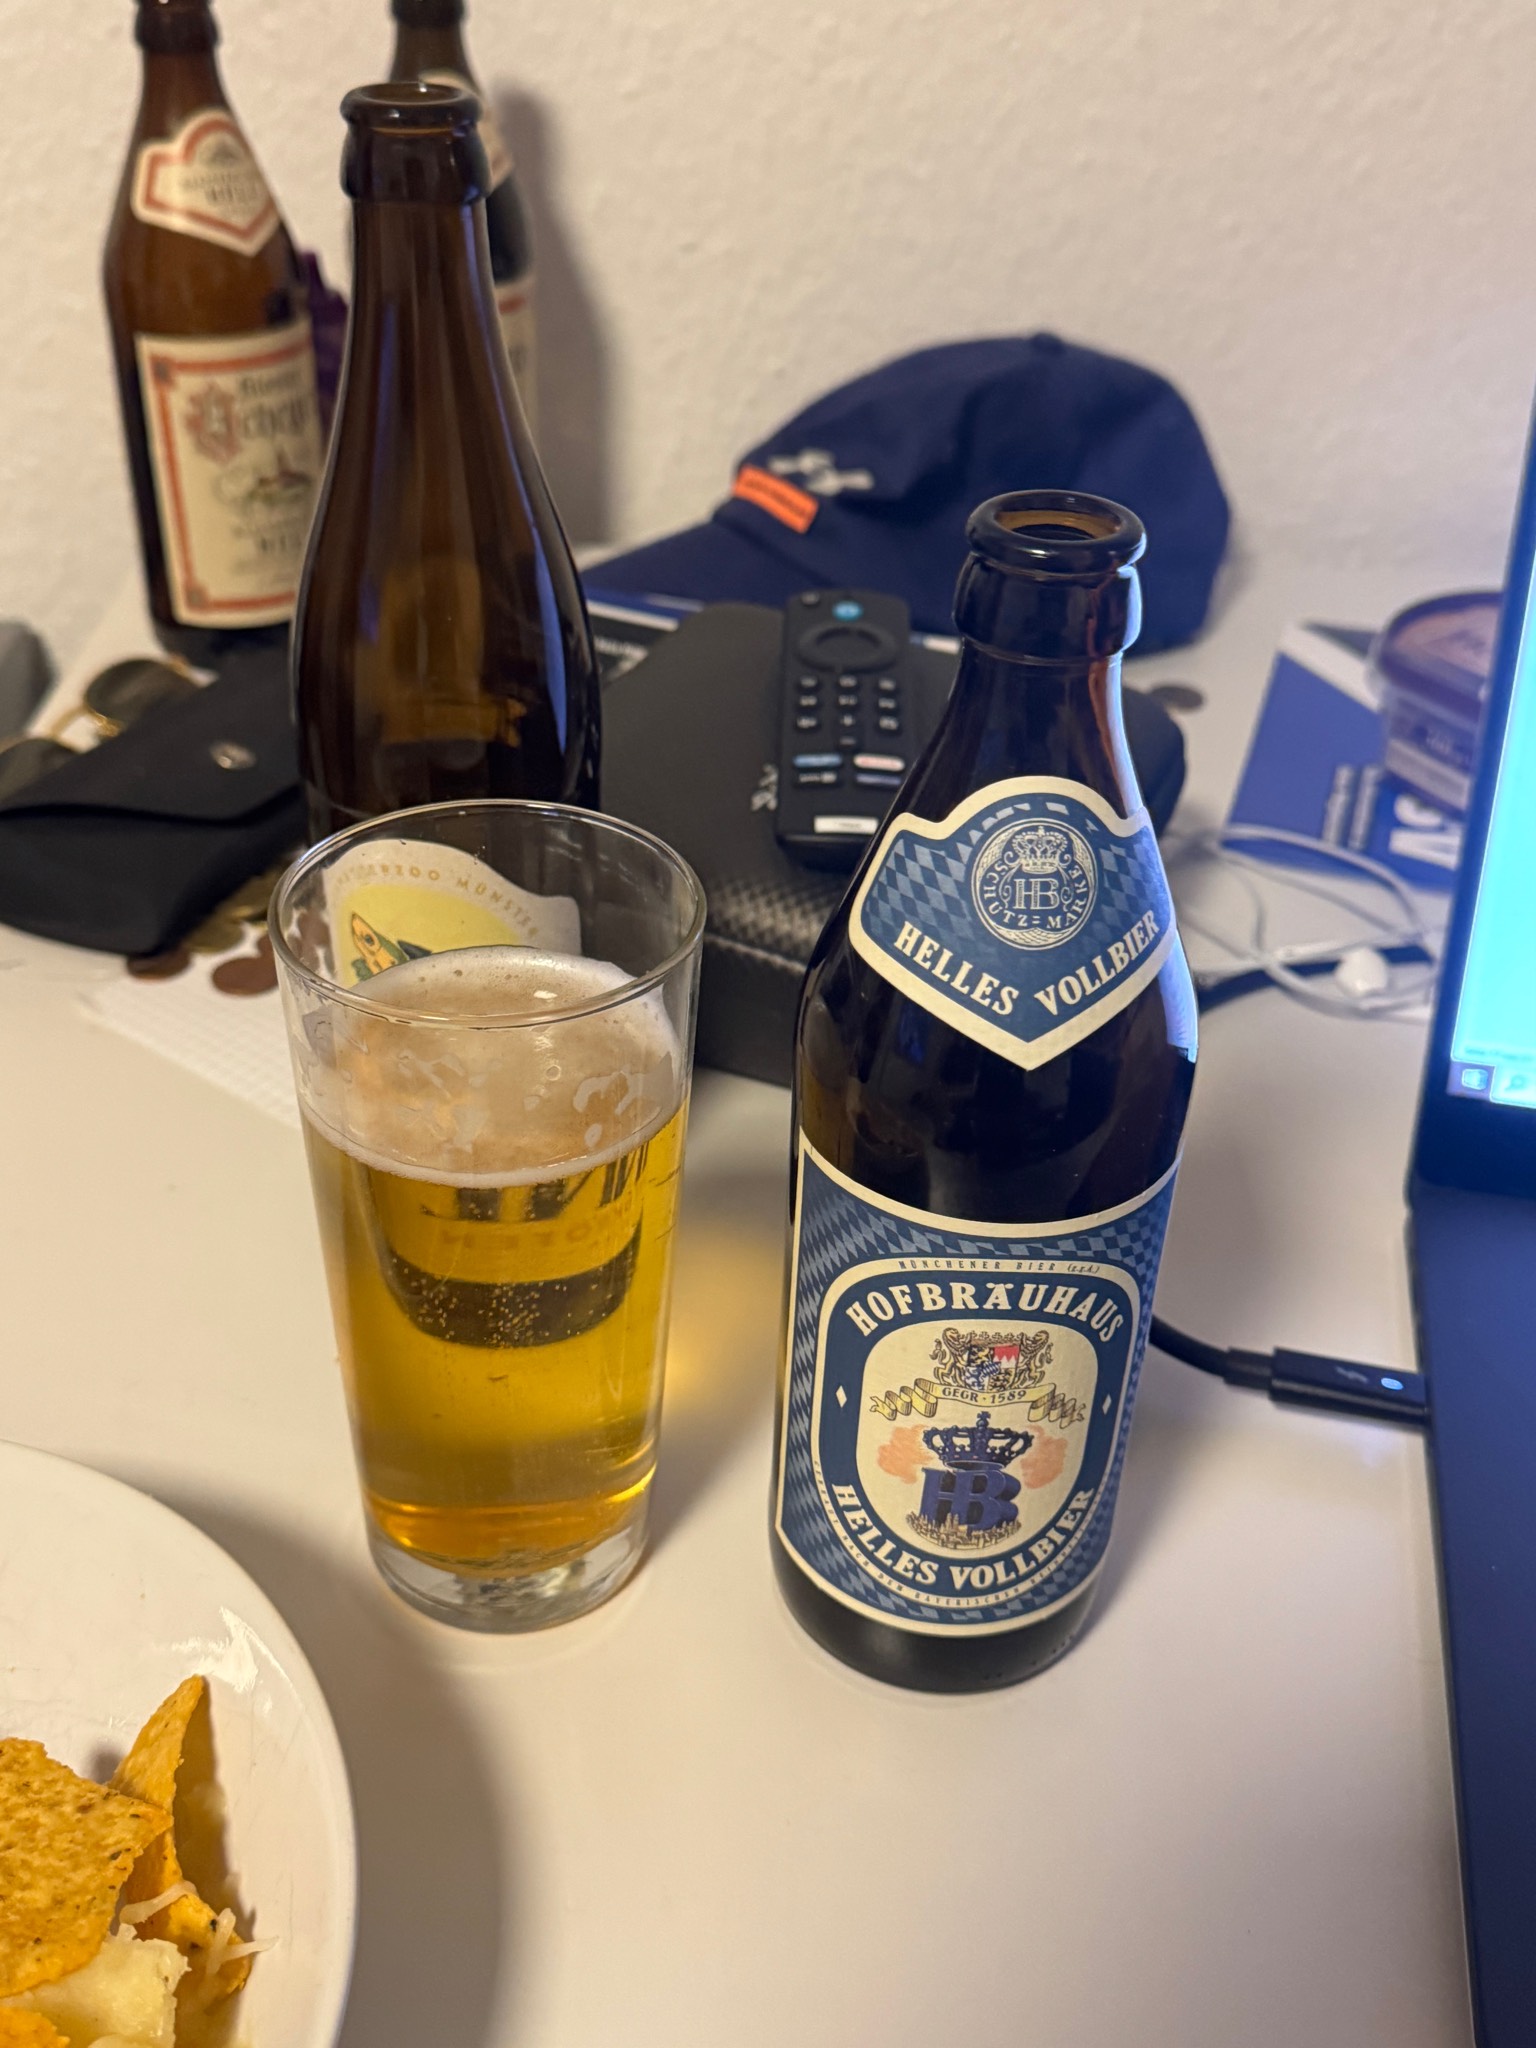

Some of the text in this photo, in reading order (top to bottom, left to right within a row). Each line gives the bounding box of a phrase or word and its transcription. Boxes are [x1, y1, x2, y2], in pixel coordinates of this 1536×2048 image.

[894, 910, 1160, 1016] HELLES VOLLBIER
[1016, 1261, 1056, 1271] BIER
[845, 1281, 1124, 1343] HOFBRÄUHAUS
[942, 1386, 1028, 1404] GEGR 1589
[831, 1483, 1095, 1591] HELLES VOLLBIER
[877, 1572, 904, 1592] DEM
